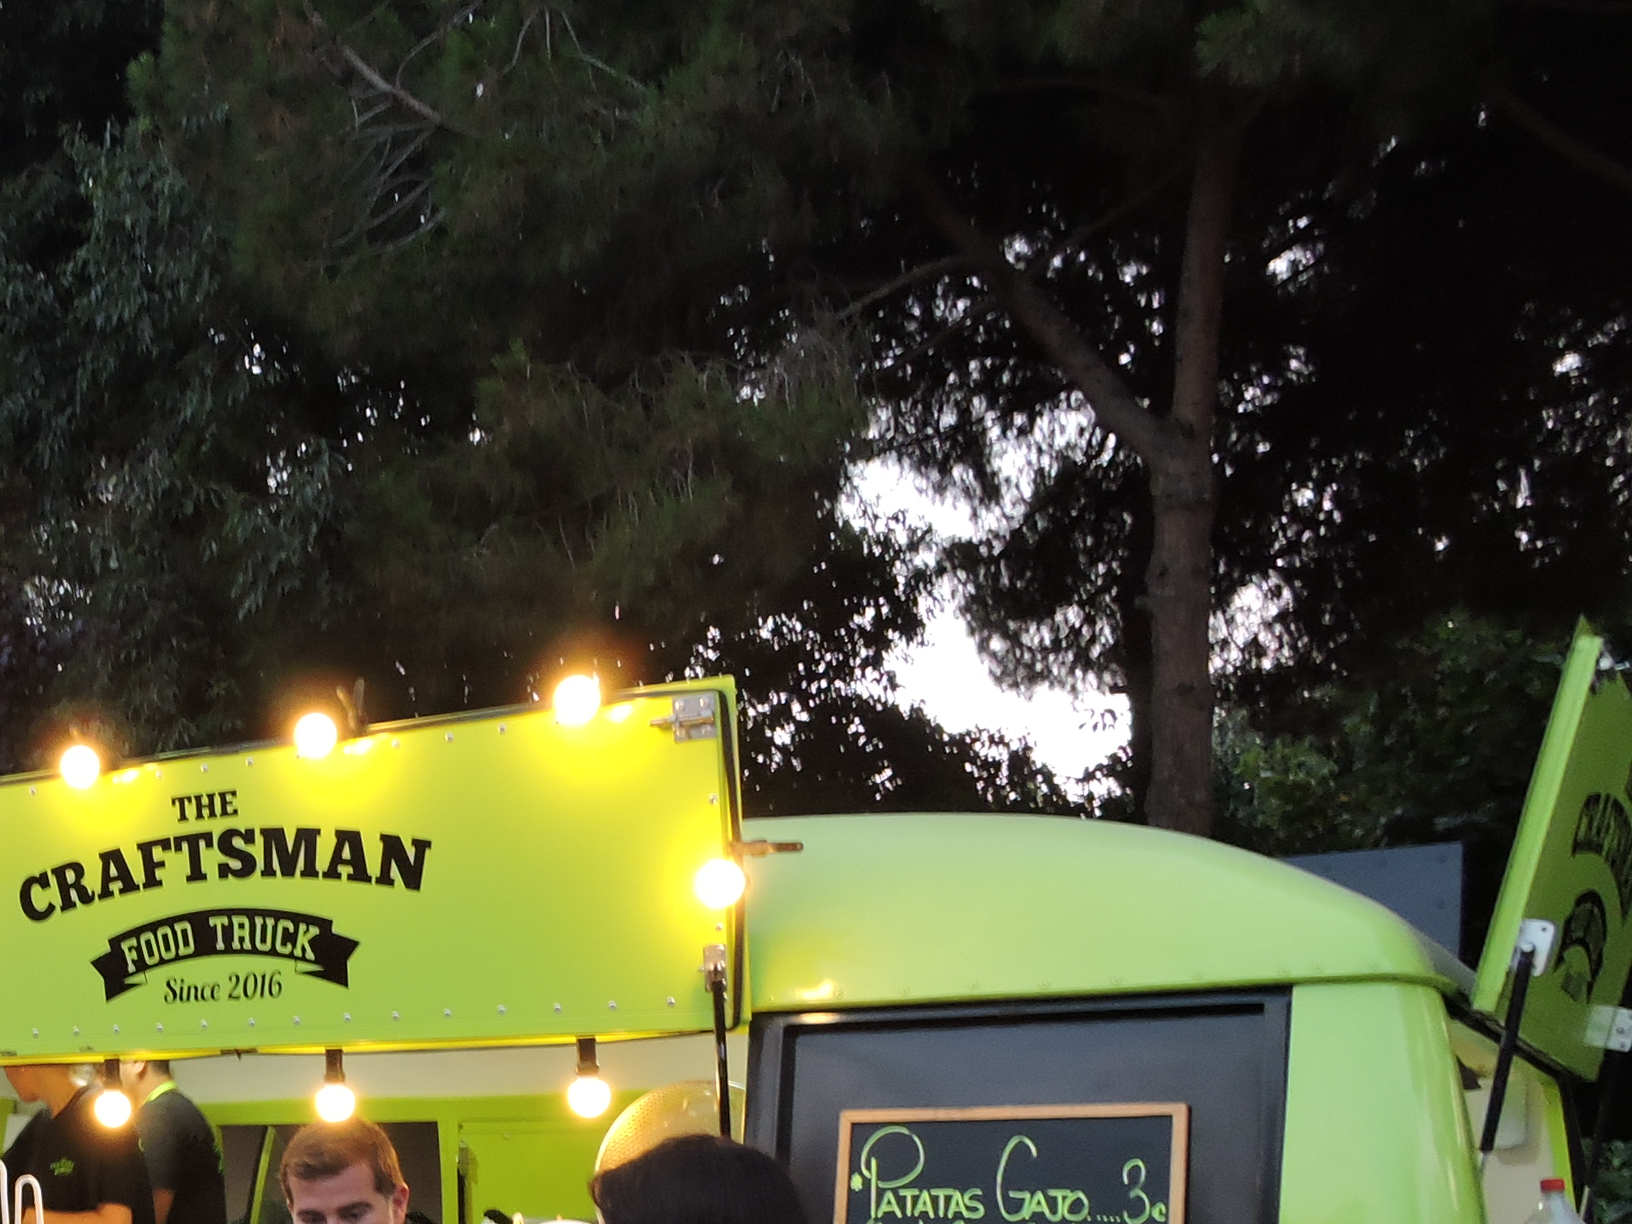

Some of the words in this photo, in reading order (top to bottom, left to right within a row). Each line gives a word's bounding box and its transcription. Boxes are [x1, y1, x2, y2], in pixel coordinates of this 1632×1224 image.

[171, 790, 238, 822] THE
[19, 827, 432, 921] CRAFTSMAN
[120, 919, 196, 973] FOOD
[208, 914, 320, 961] TRUCK
[164, 974, 220, 1004] Since
[228, 970, 284, 1001] 2016
[861, 1125, 985, 1219] PATATAS
